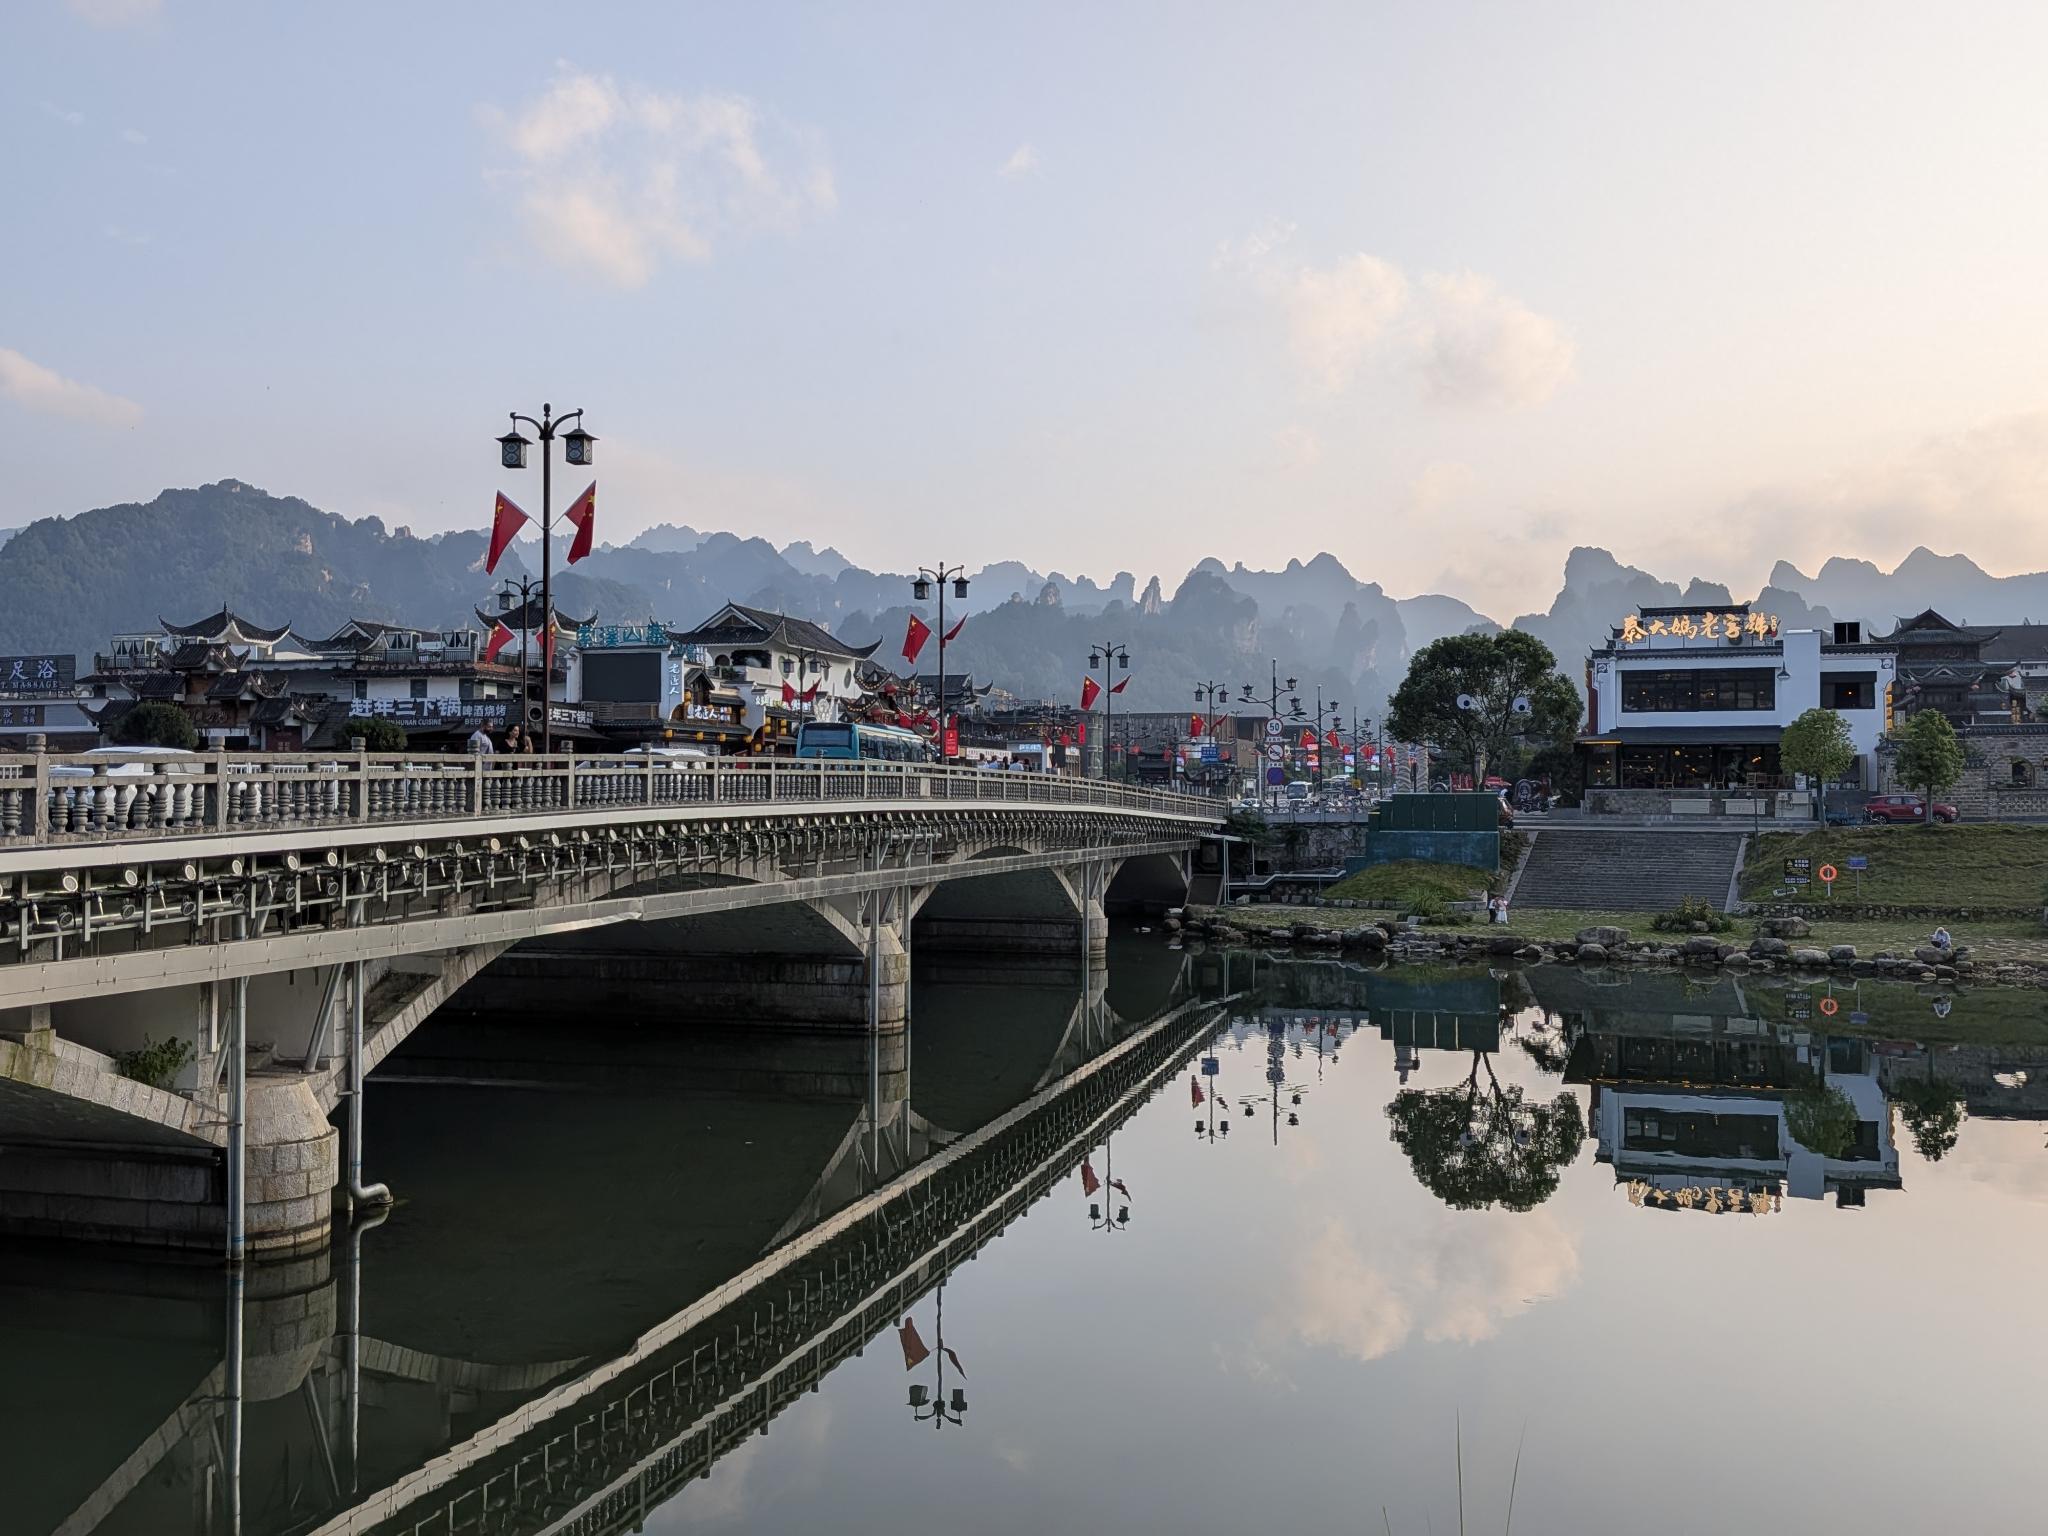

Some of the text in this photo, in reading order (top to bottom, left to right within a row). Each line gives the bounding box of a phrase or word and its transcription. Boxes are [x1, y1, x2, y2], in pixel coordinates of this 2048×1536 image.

[9, 660, 58, 680] 足浴
[12, 681, 58, 689] MASSAGE
[462, 704, 507, 717] 啤酒烧烤
[1269, 722, 1280, 732] 50
